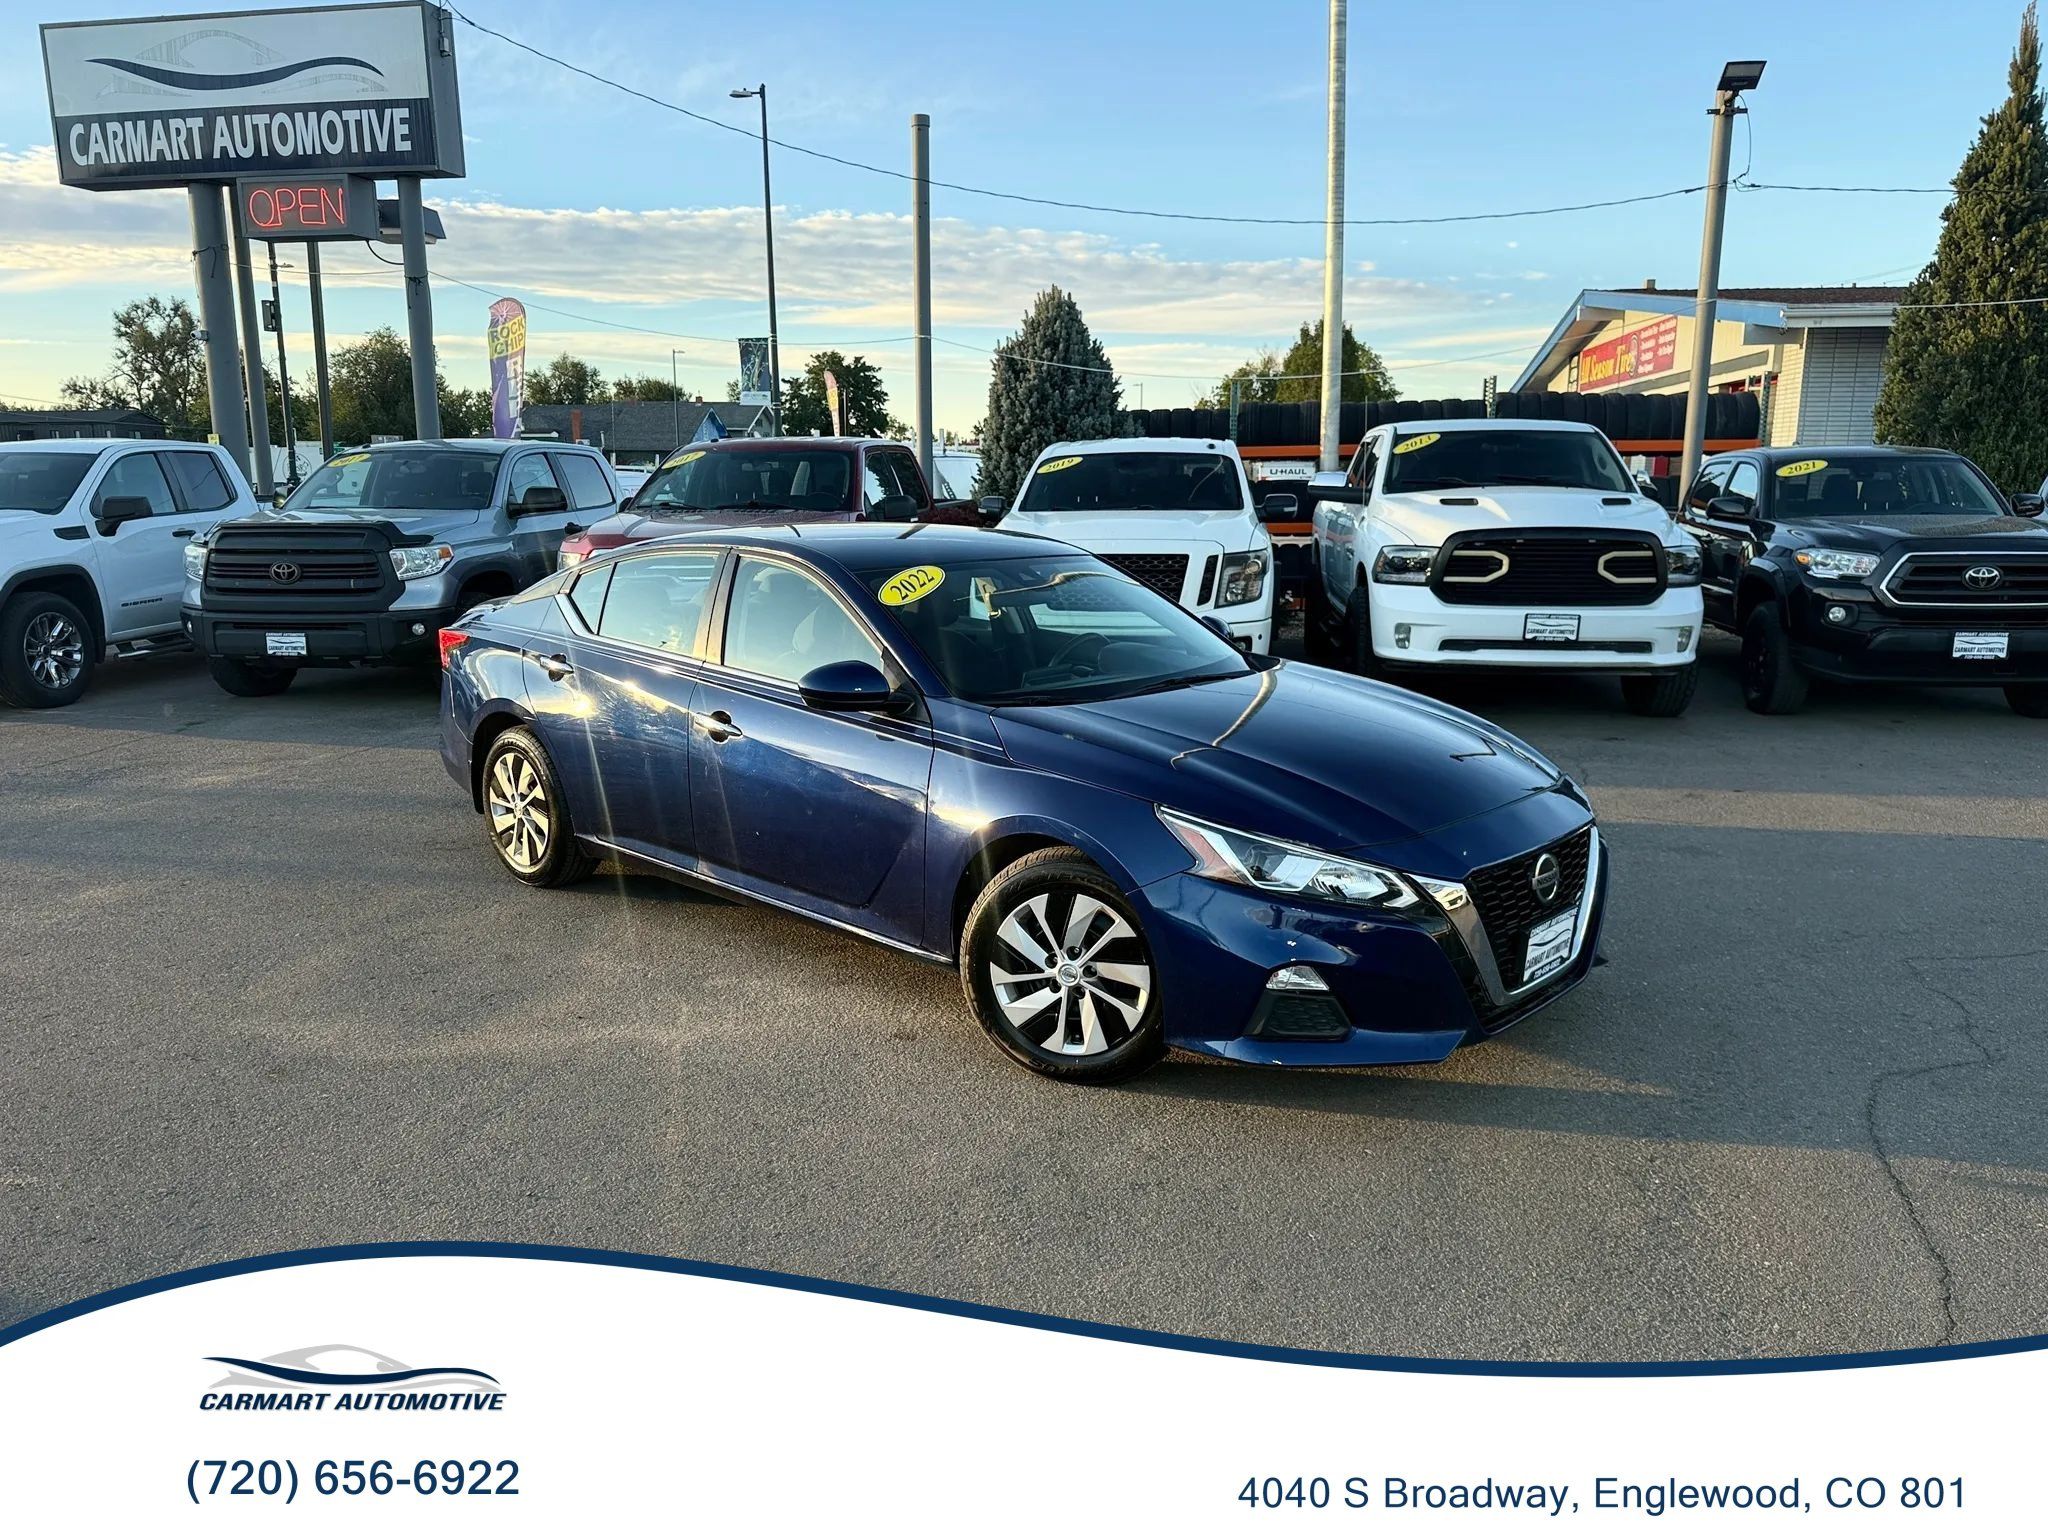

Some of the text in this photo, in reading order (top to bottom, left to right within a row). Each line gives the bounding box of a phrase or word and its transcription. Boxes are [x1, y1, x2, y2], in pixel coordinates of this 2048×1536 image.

[69, 107, 412, 166] CARMART AUTOMOTIVE
[248, 187, 345, 228] OPEN
[490, 318, 525, 343] ROCK
[494, 332, 524, 356] CHIP
[1046, 459, 1074, 471] 2019
[1787, 461, 1816, 474] 2021
[890, 569, 935, 600] 2022
